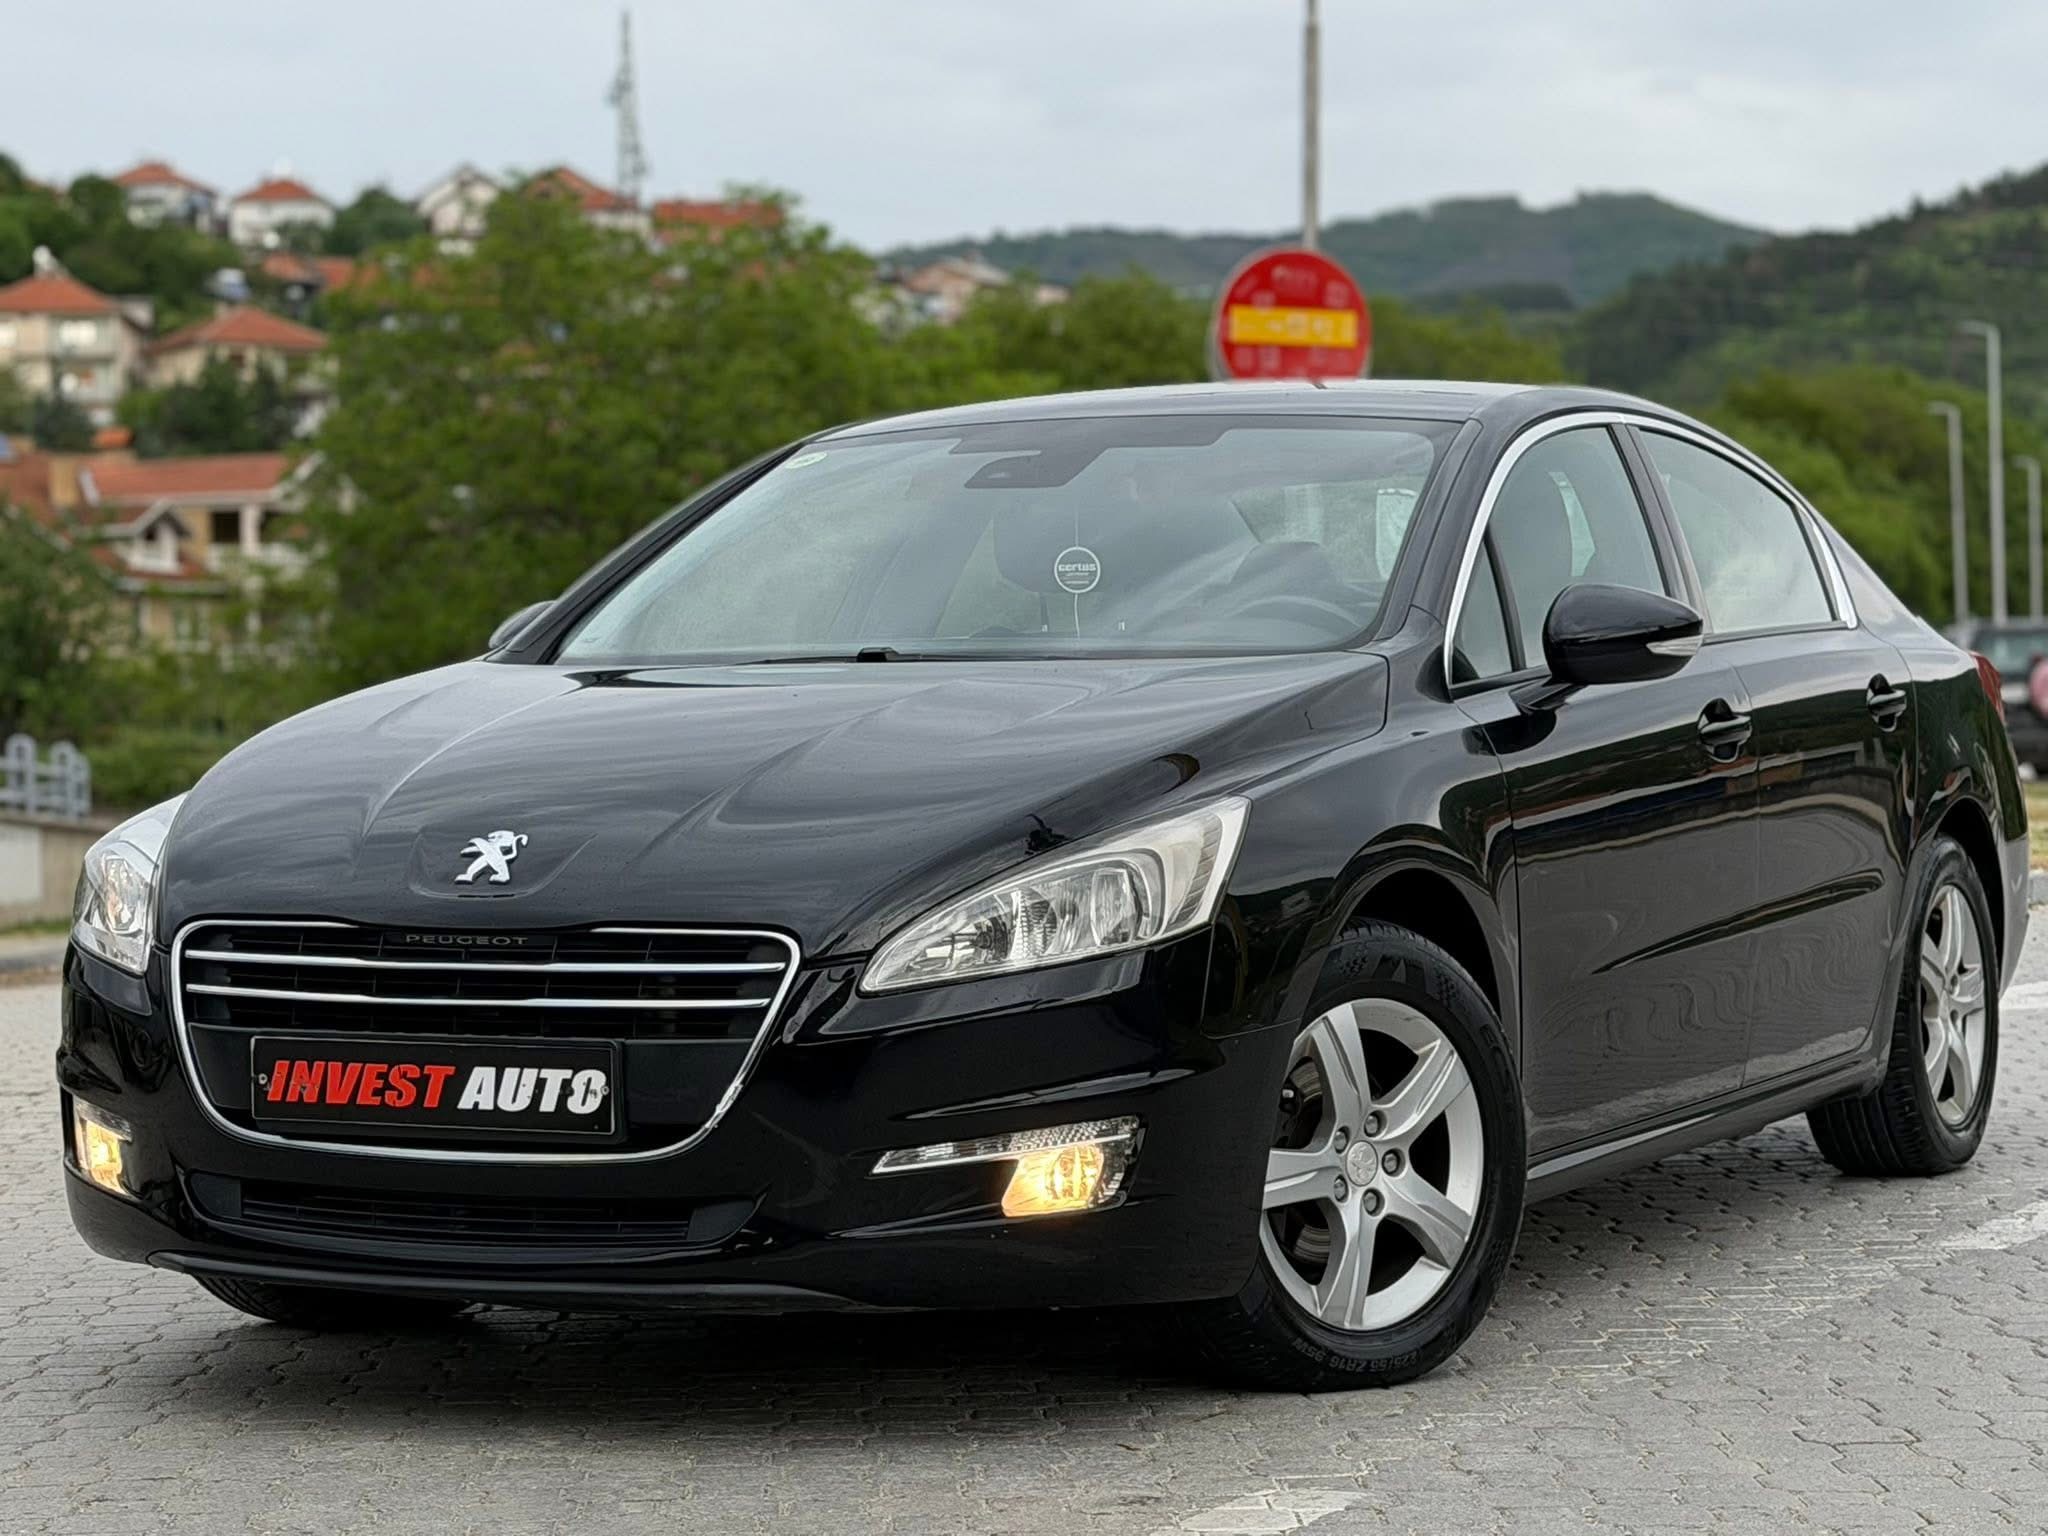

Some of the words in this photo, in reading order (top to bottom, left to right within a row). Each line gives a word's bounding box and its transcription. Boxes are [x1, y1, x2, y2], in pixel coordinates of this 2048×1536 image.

[406, 934, 529, 946] PEUGEOT
[267, 1060, 456, 1108] INVEST
[457, 1066, 607, 1114] AUTO
